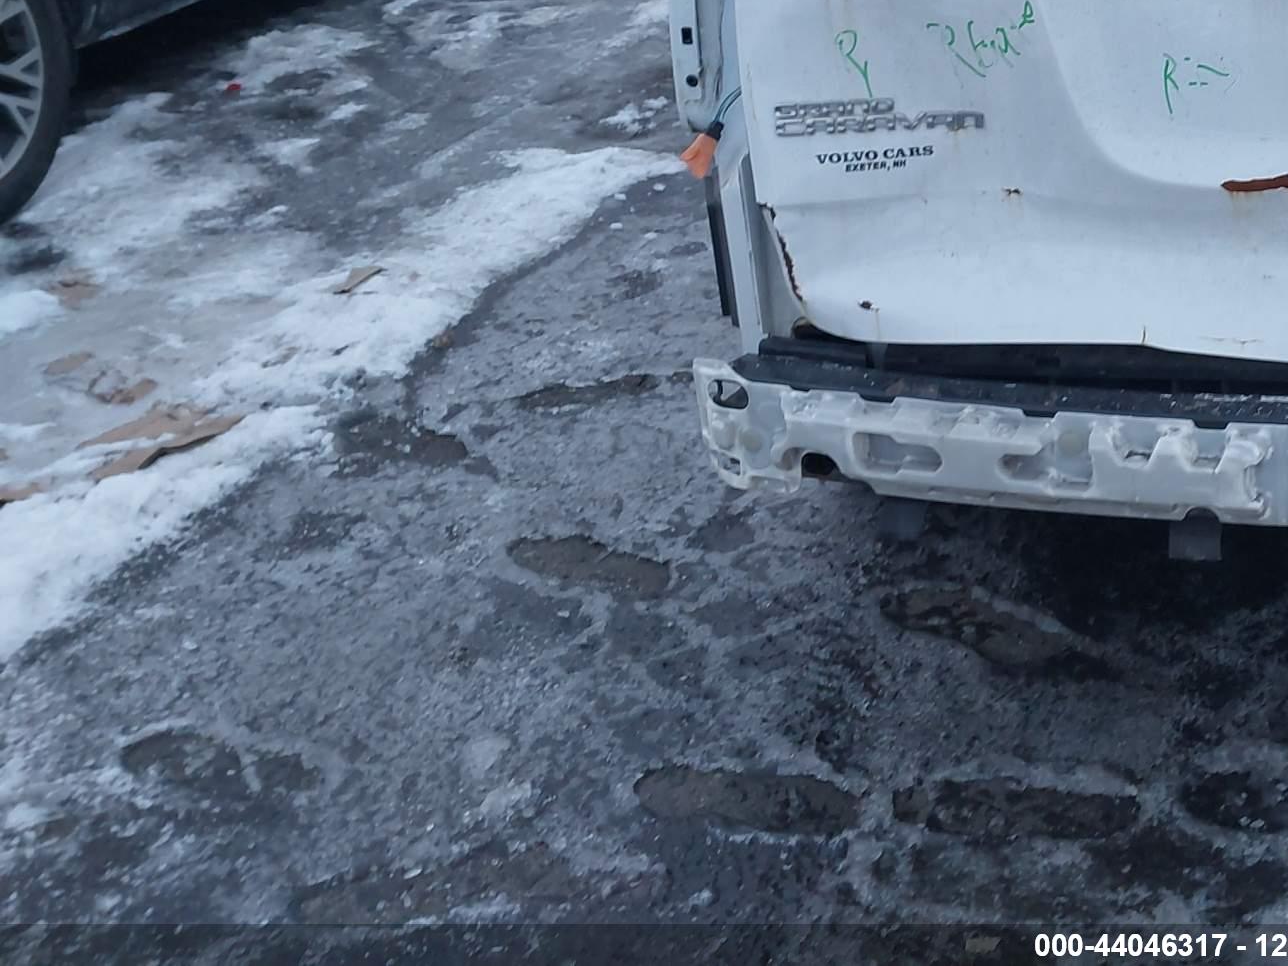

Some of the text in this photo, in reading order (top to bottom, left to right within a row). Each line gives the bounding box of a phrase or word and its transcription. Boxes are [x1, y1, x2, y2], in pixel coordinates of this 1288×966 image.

[775, 110, 985, 137] CARAVAN
[816, 145, 935, 165] VOLVO CARS
[845, 161, 890, 173] EXETER,
